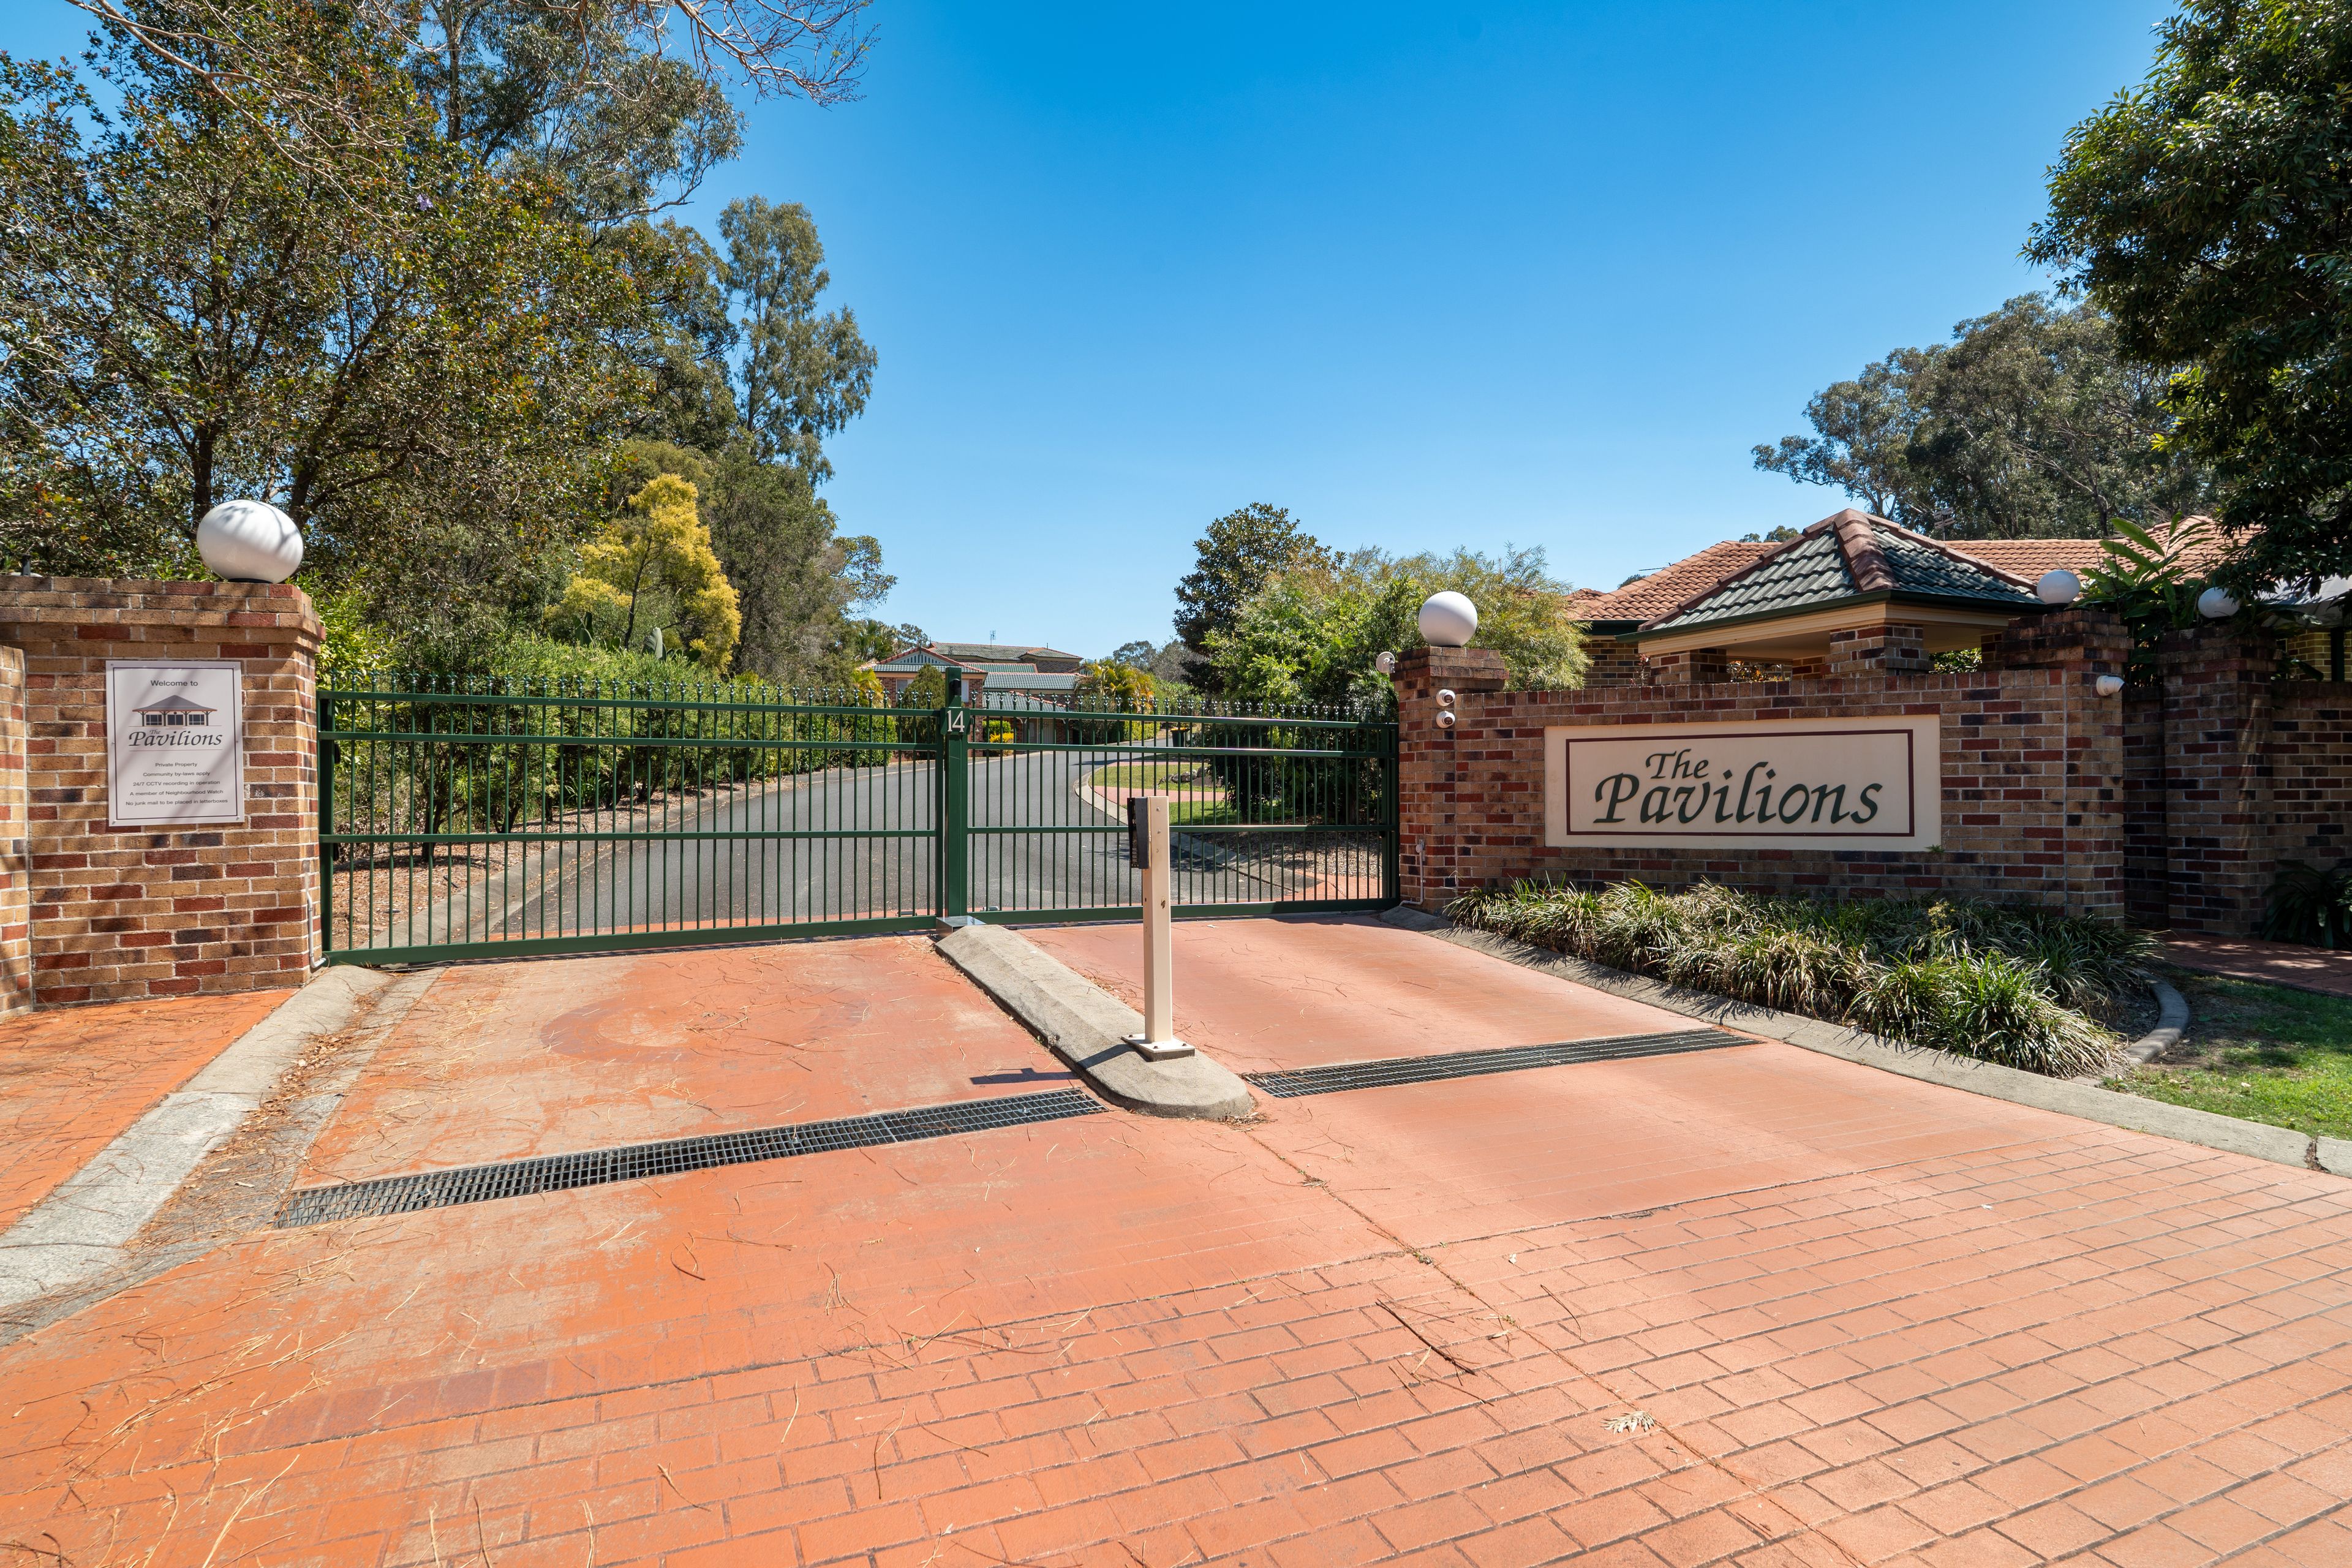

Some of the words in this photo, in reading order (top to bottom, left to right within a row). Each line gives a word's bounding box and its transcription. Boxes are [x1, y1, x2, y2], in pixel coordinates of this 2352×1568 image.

[947, 710, 965, 733] 14
[128, 730, 223, 747] Pavilions
[1645, 748, 1709, 780] The
[1593, 761, 1883, 825] Pavilions
